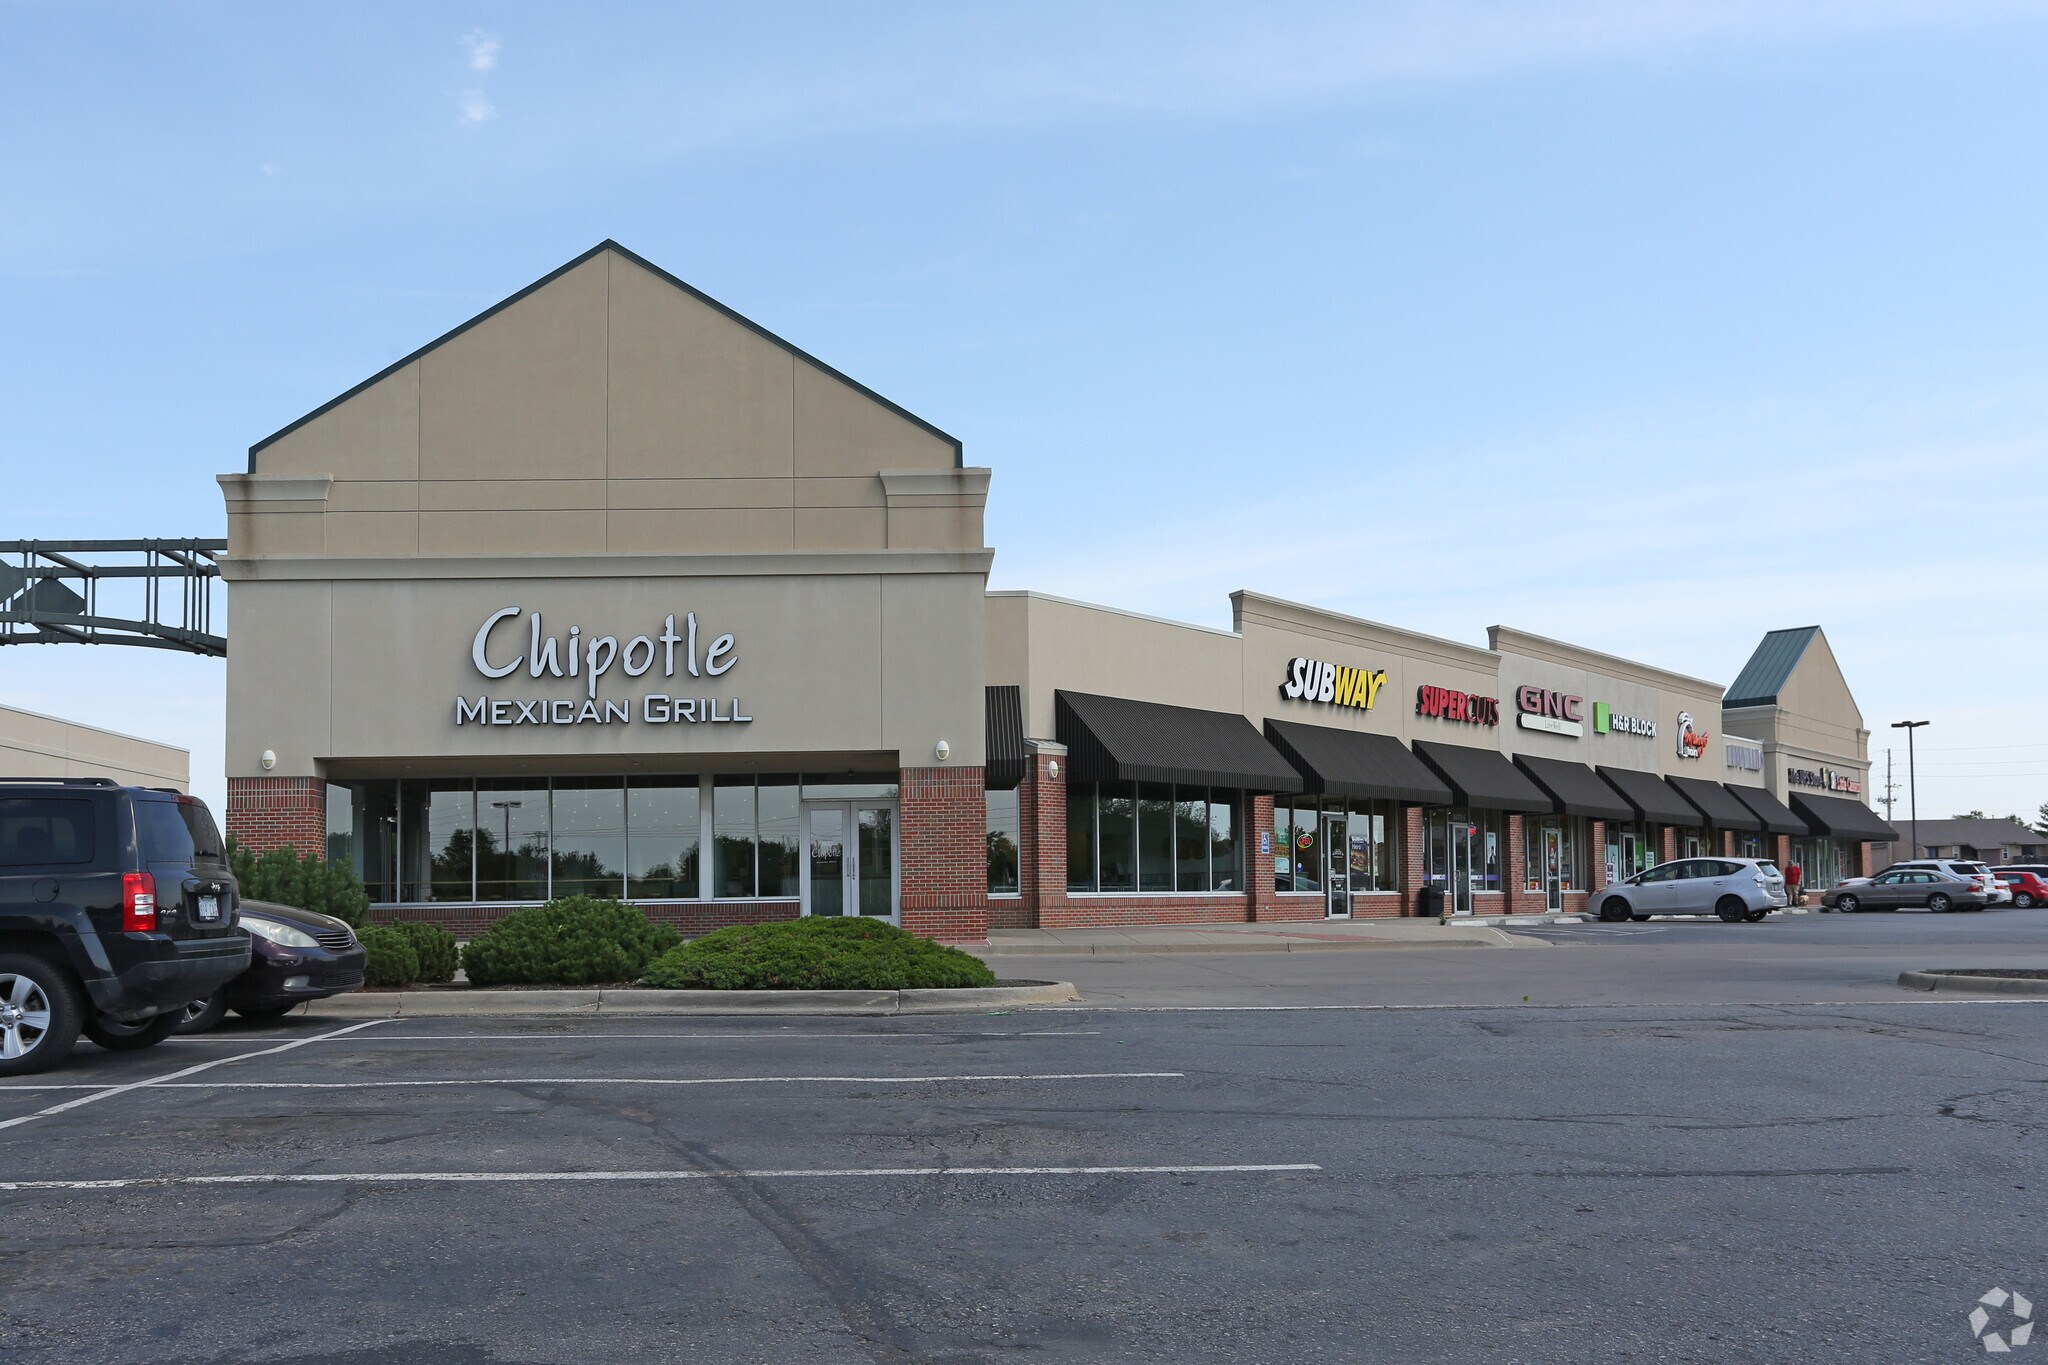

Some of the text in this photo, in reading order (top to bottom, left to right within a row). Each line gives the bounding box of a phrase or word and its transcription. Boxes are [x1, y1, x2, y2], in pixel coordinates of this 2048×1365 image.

[472, 606, 739, 700] Chipotle
[1284, 657, 1389, 709] SUBWAY
[456, 693, 753, 725] MEXICAN GRILL
[1420, 684, 1500, 726] SUPERCUTS
[1520, 685, 1584, 721] GNC
[1612, 713, 1657, 737] H&R BLOCK
